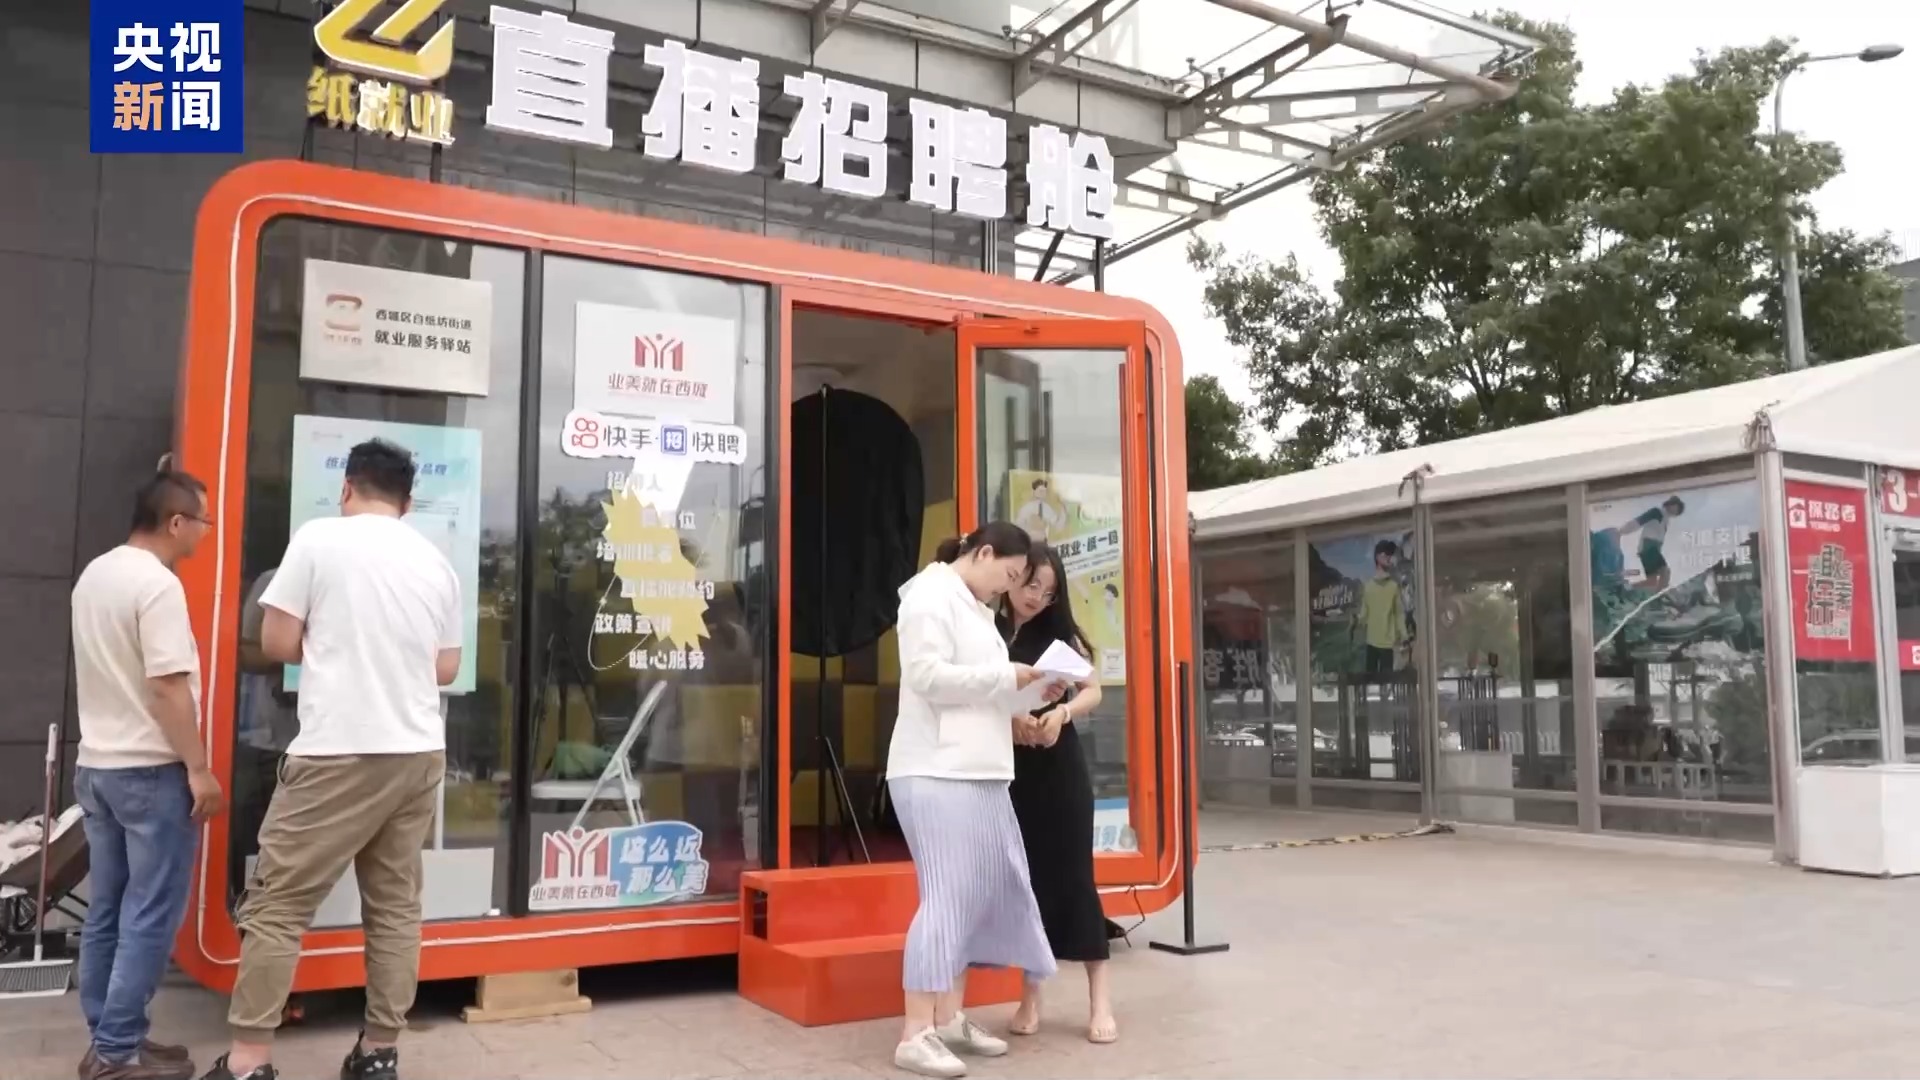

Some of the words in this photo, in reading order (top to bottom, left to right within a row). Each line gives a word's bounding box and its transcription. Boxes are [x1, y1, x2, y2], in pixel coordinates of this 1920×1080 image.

[306, 66, 455, 146] 纸就业
[486, 5, 1117, 239] 直播招聘舱
[374, 329, 472, 354] 就业服务驿站
[692, 431, 740, 454] 快聘
[629, 650, 705, 670] 暖心服务
[619, 833, 700, 864] 这么近
